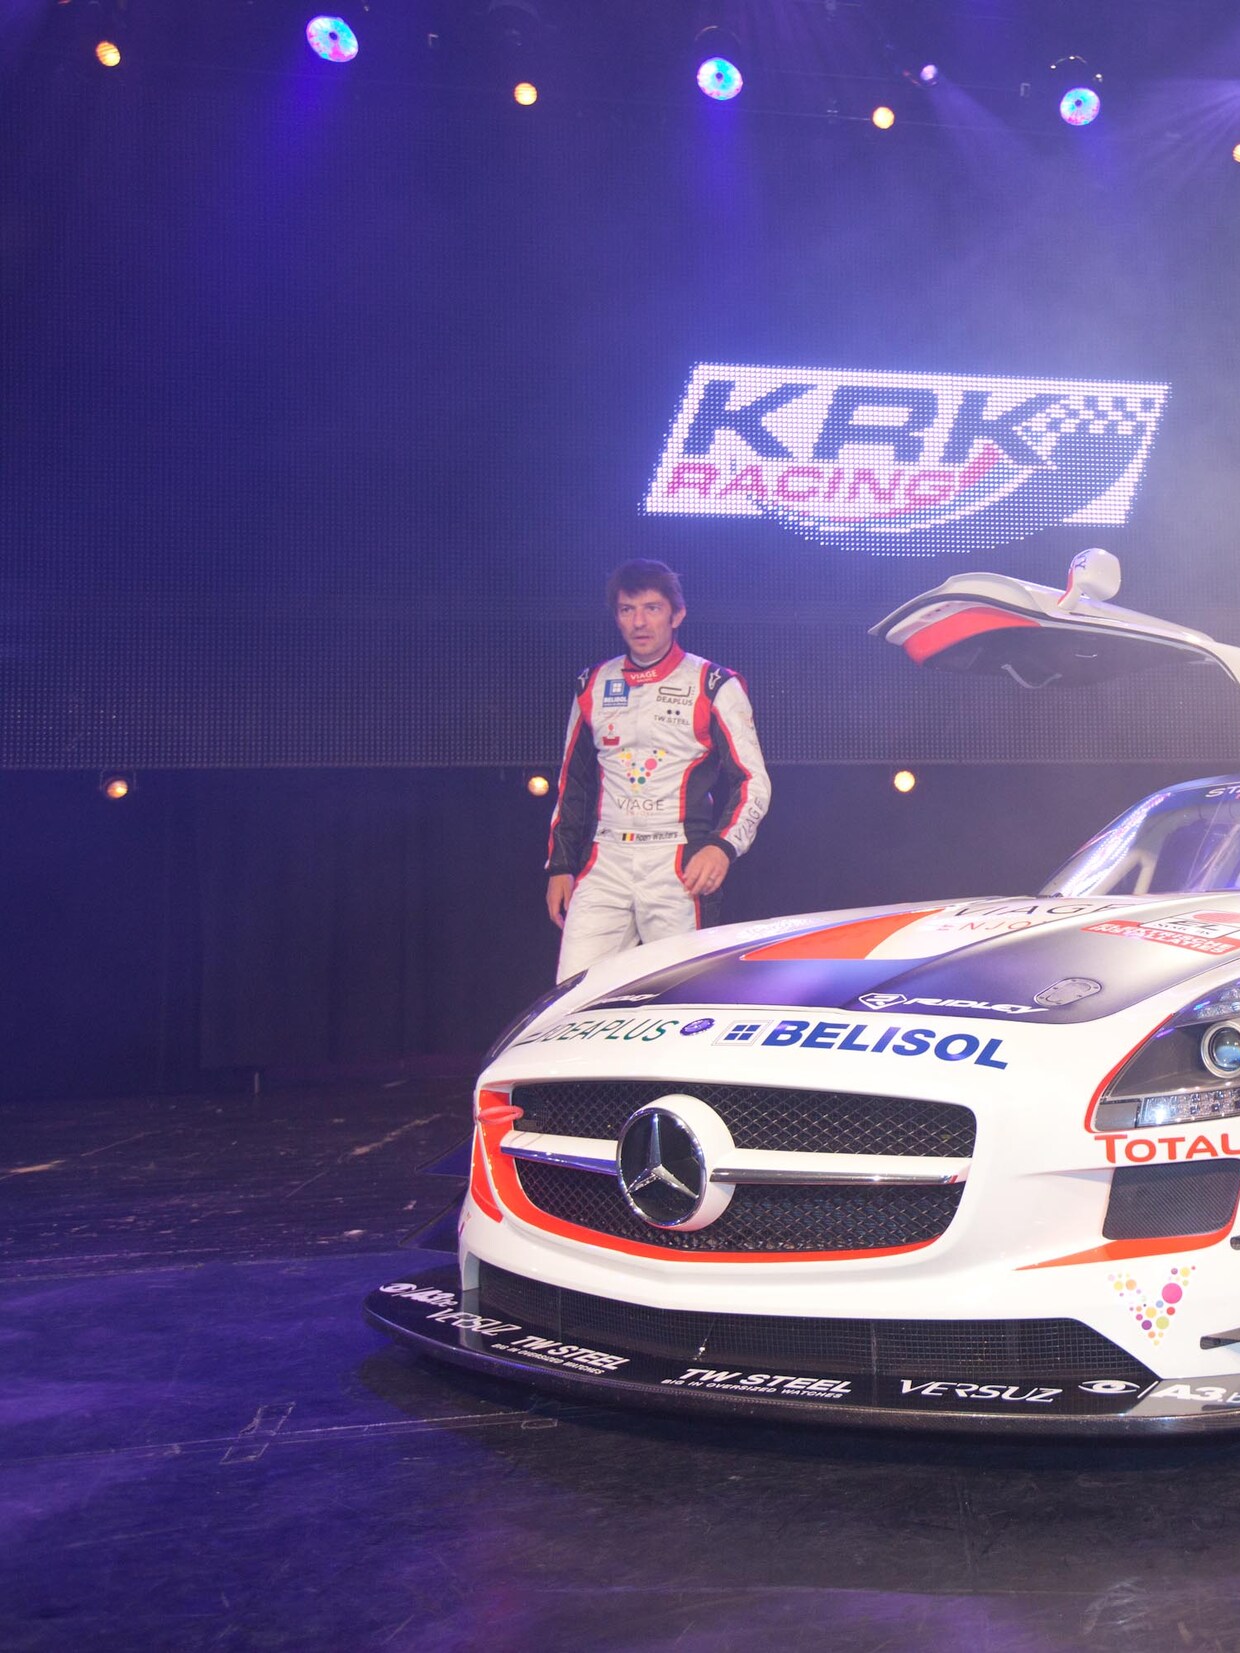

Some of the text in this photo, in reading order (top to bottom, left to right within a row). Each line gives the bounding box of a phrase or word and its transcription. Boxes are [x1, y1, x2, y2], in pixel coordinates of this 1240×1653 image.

[682, 379, 1056, 467] KRK
[666, 462, 955, 502] RACING
[630, 670, 658, 680] VIAGE
[617, 799, 664, 811] VIAGE
[735, 797, 763, 842] VIAGE
[904, 998, 1049, 1014] RIDLEY
[760, 1020, 1009, 1070] BELISOL
[426, 1308, 522, 1336] VERSUZ
[510, 1335, 631, 1370] TW STEEL
[679, 1368, 852, 1393] TW STEEL
[706, 1382, 777, 1393] OVERSIZED
[781, 1389, 843, 1399] WATCHES
[900, 1379, 1065, 1403] VERSUZ
